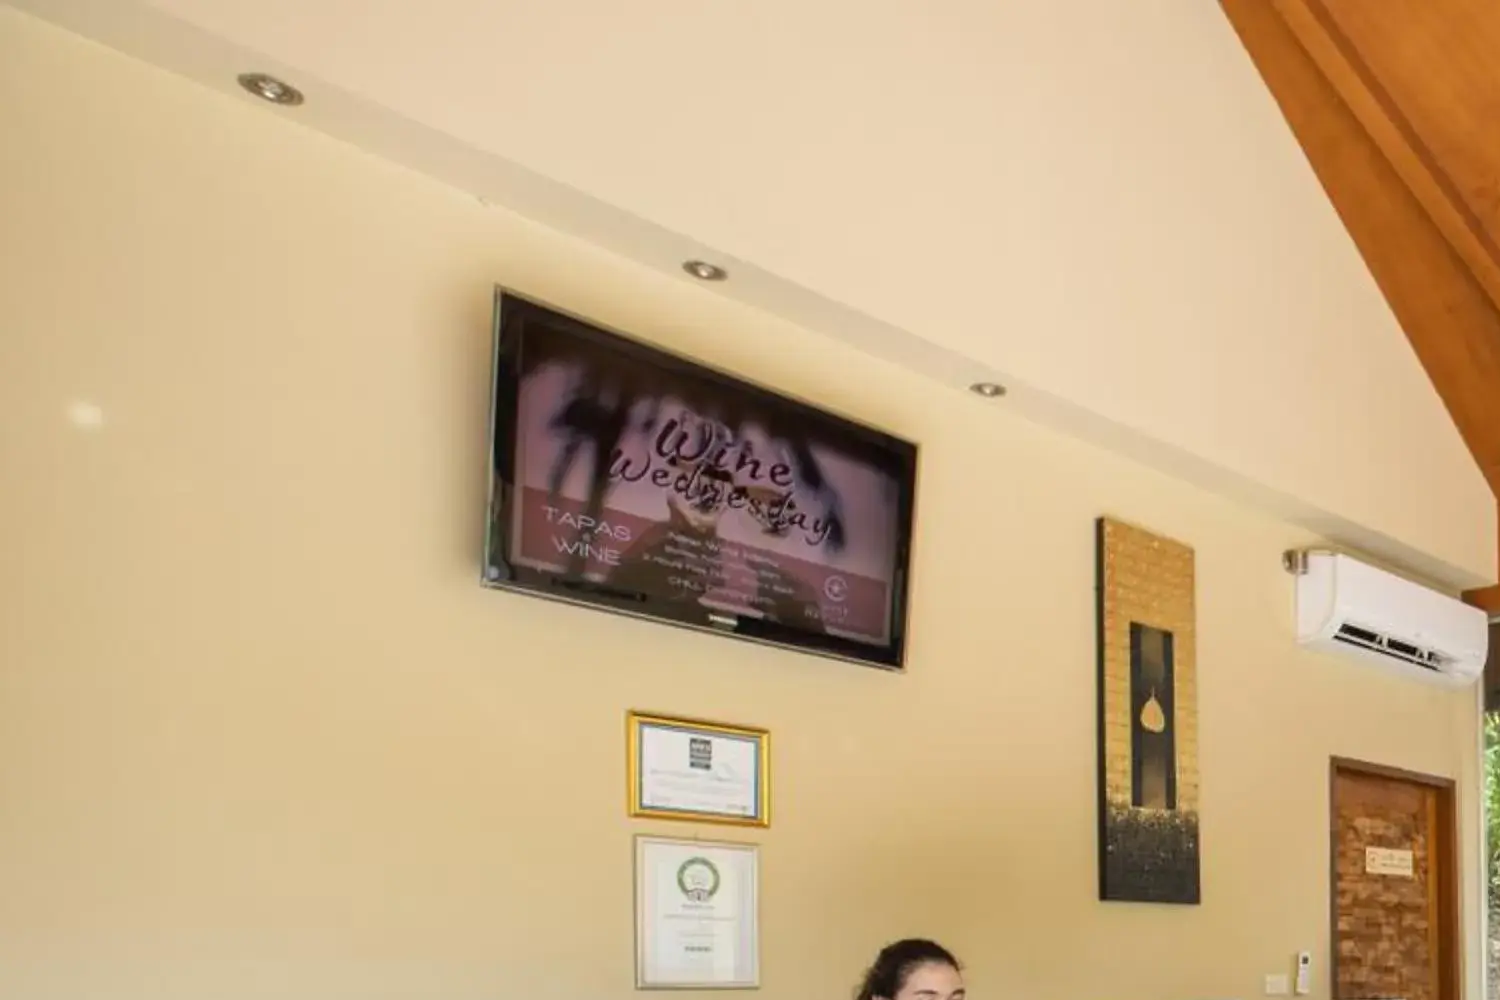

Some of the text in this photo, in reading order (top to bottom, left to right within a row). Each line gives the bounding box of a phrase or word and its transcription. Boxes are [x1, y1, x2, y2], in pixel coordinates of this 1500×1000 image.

[656, 416, 795, 487] Wine
[541, 505, 631, 541] TAPAS
[610, 449, 834, 546] Wednesday
[551, 534, 622, 566] WINE
